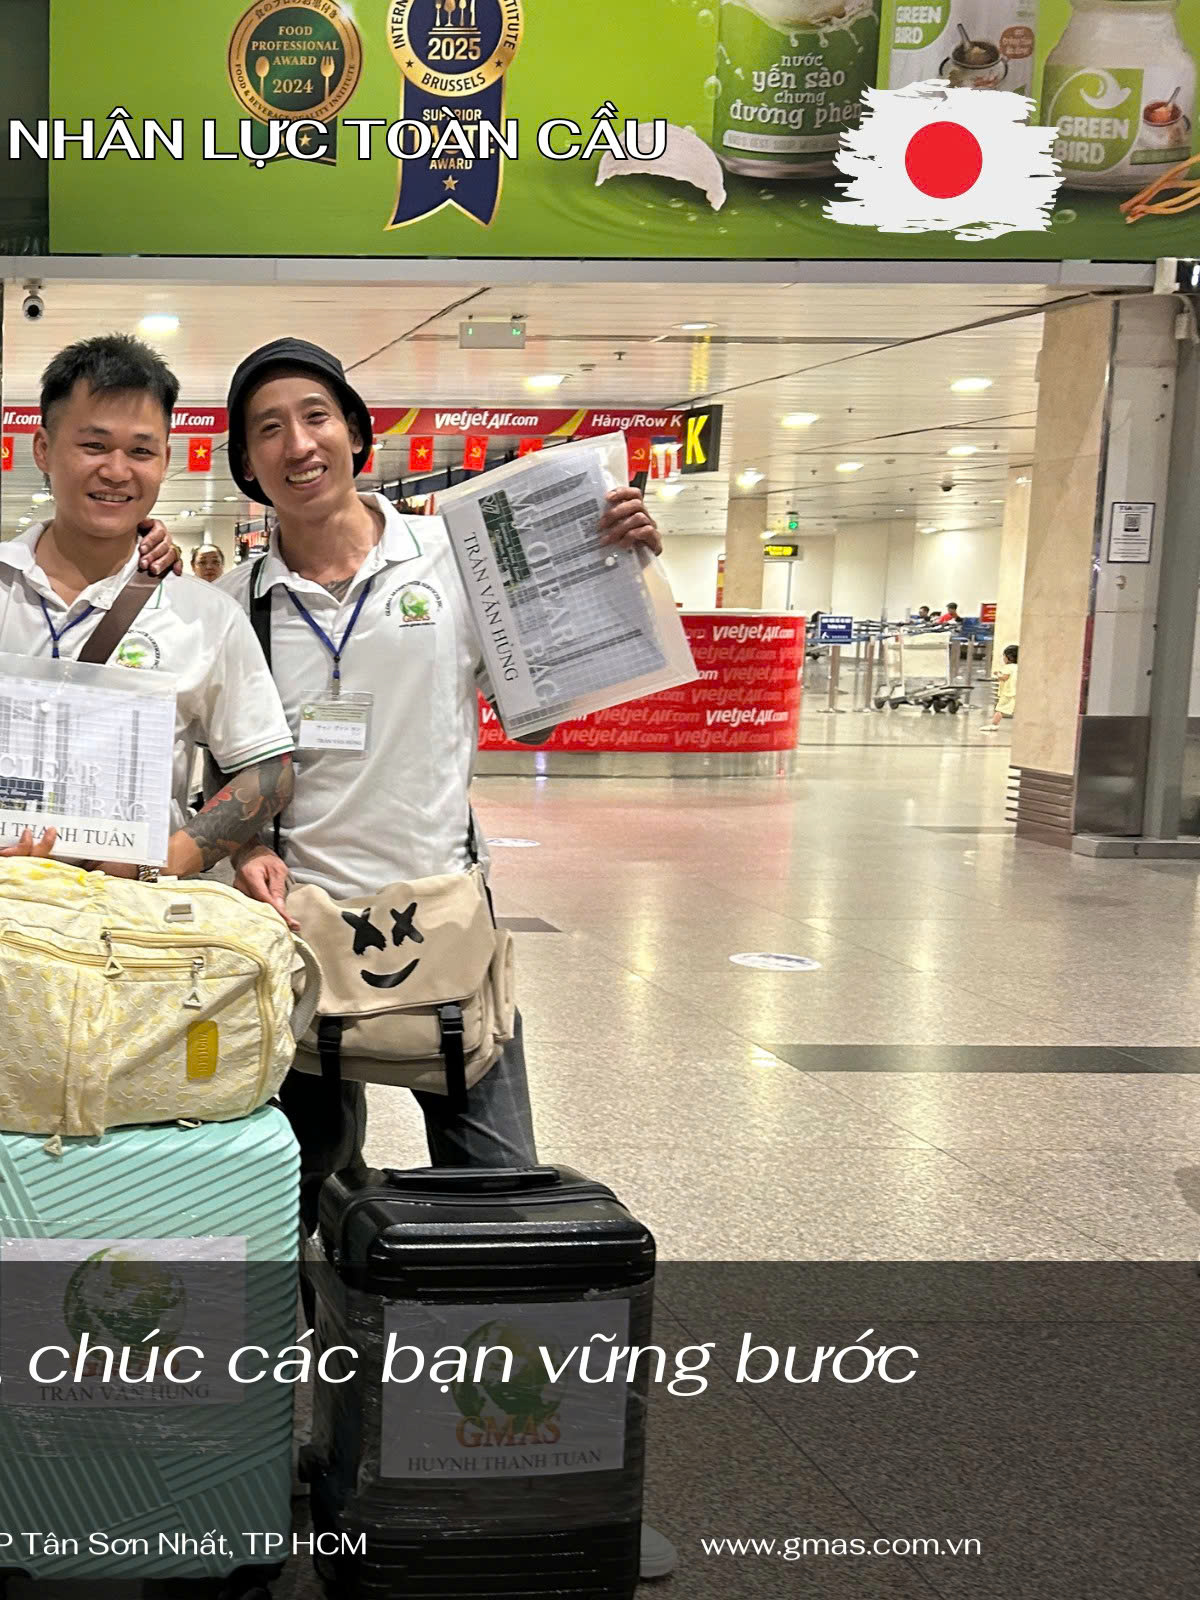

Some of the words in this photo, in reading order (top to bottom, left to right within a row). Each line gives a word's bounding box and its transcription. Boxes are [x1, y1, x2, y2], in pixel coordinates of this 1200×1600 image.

[895, 6, 942, 25] GREEN
[278, 26, 313, 36] FOOD
[894, 26, 923, 45] BIRD
[252, 40, 339, 51] PROFESSIONAL
[428, 37, 481, 60] 2025
[272, 55, 317, 66] AWARD
[781, 53, 823, 67] nước
[235, 63, 247, 91] FOOD
[329, 64, 355, 109] INSTITUTE
[272, 79, 314, 94] 2024
[421, 72, 486, 92] BRUSSELS
[752, 63, 796, 92] yến
[805, 67, 845, 89] sào
[774, 90, 826, 105] chưng
[729, 99, 804, 129] đường
[1057, 115, 1130, 140] GREEN
[1053, 140, 1106, 165] BIRD
[430, 158, 472, 170] AWARD
[592, 413, 668, 430] Hàng/Row
[670, 415, 682, 427] K
[685, 414, 710, 465] K
[456, 1414, 561, 1448] GMAS
[480, 1454, 547, 1471] THANH
